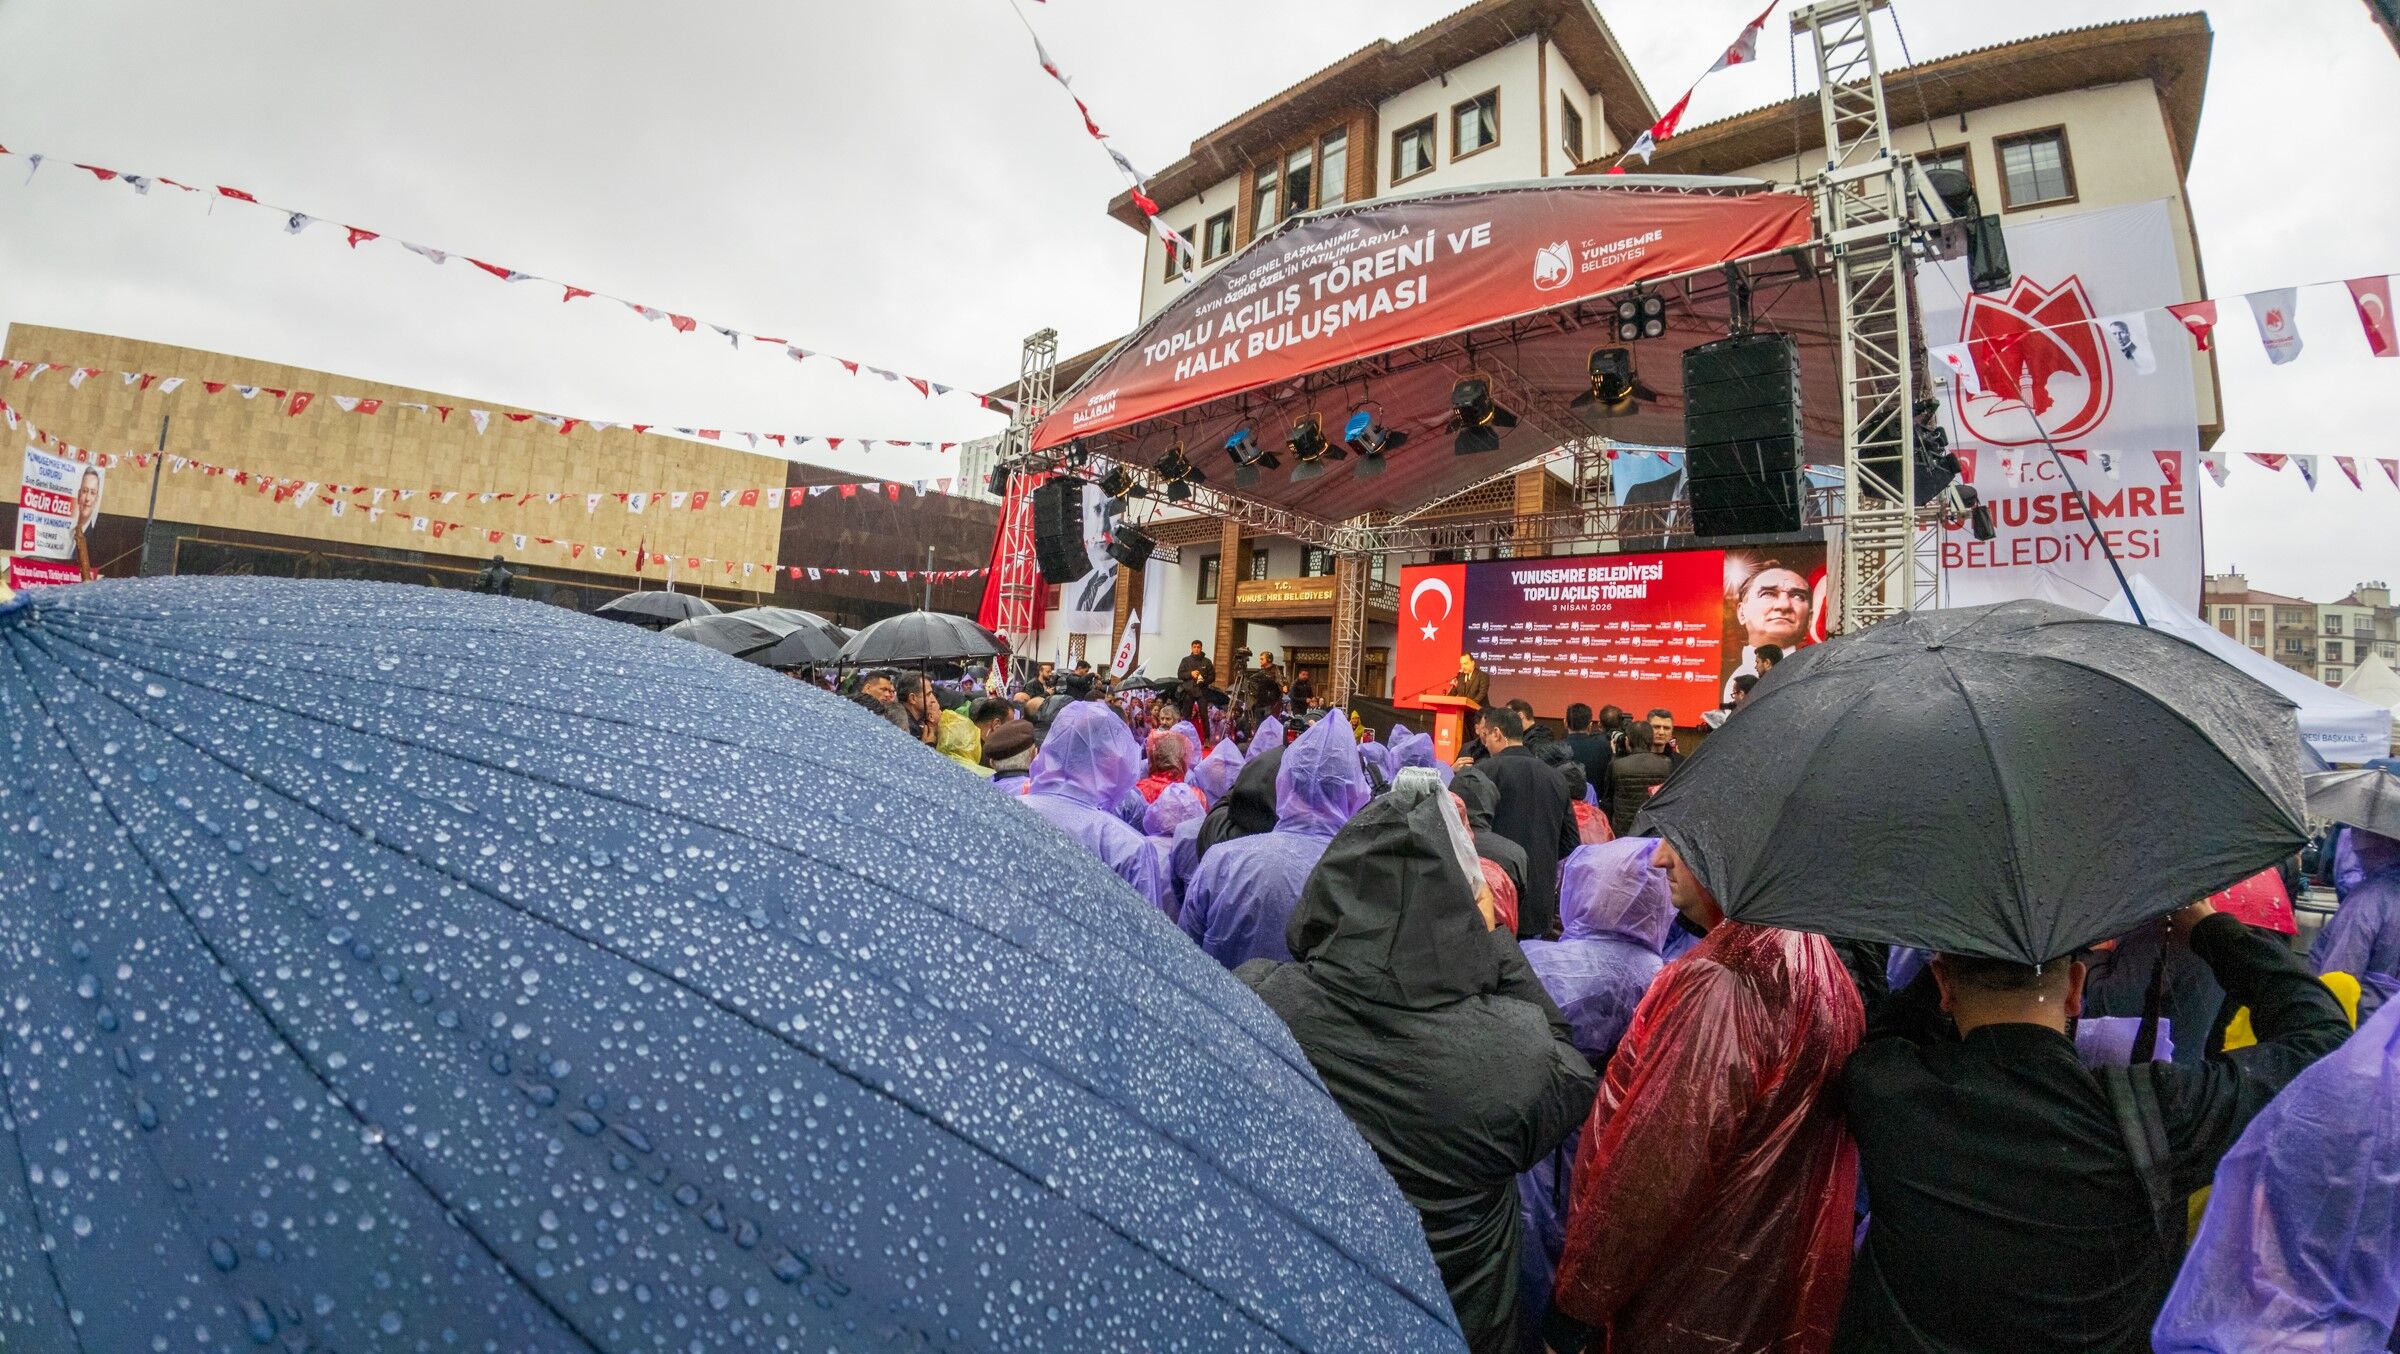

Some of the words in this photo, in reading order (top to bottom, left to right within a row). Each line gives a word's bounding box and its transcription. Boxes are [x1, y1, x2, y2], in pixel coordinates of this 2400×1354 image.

[1581, 239, 1597, 249] T.C.
[1581, 229, 1663, 261] YUNUSEMRE
[1195, 297, 1223, 317] SAYIN
[1224, 280, 1257, 304] ÖZGÜR
[1259, 263, 1299, 293] ÖZEL'İN
[1301, 224, 1410, 271] KATILIMLARIYLA
[1228, 274, 1248, 290] CHP
[1249, 259, 1281, 282] GENEL
[1283, 227, 1361, 263] BAŞKANIMIZ
[1144, 319, 1213, 367] TOPLU
[1217, 283, 1301, 339] AÇILIŞ
[1309, 229, 1436, 301] TÖRENİ
[1447, 221, 1492, 255] VE
[1174, 338, 1241, 382] HALK
[1247, 274, 1428, 360] BULUŞMASI
[1073, 400, 1116, 425] BALABAN
[51, 493, 72, 516] ÖZEL
[1511, 567, 1586, 585] YUNUSEMRE
[1588, 560, 1663, 582] BELEDİYESİ
[1236, 594, 1284, 603] YUNUSEMRE
[1284, 590, 1333, 601] BELEDİYESİ
[1274, 581, 1291, 590] T.C.
[1523, 587, 1559, 602] TOPLU
[1561, 585, 1600, 603] AÇILIŞ
[1601, 581, 1647, 600] TÖRENİ
[1560, 603, 1588, 611] NİSAN
[1591, 603, 1612, 611] 2026
[1117, 642, 1131, 668] ADD
